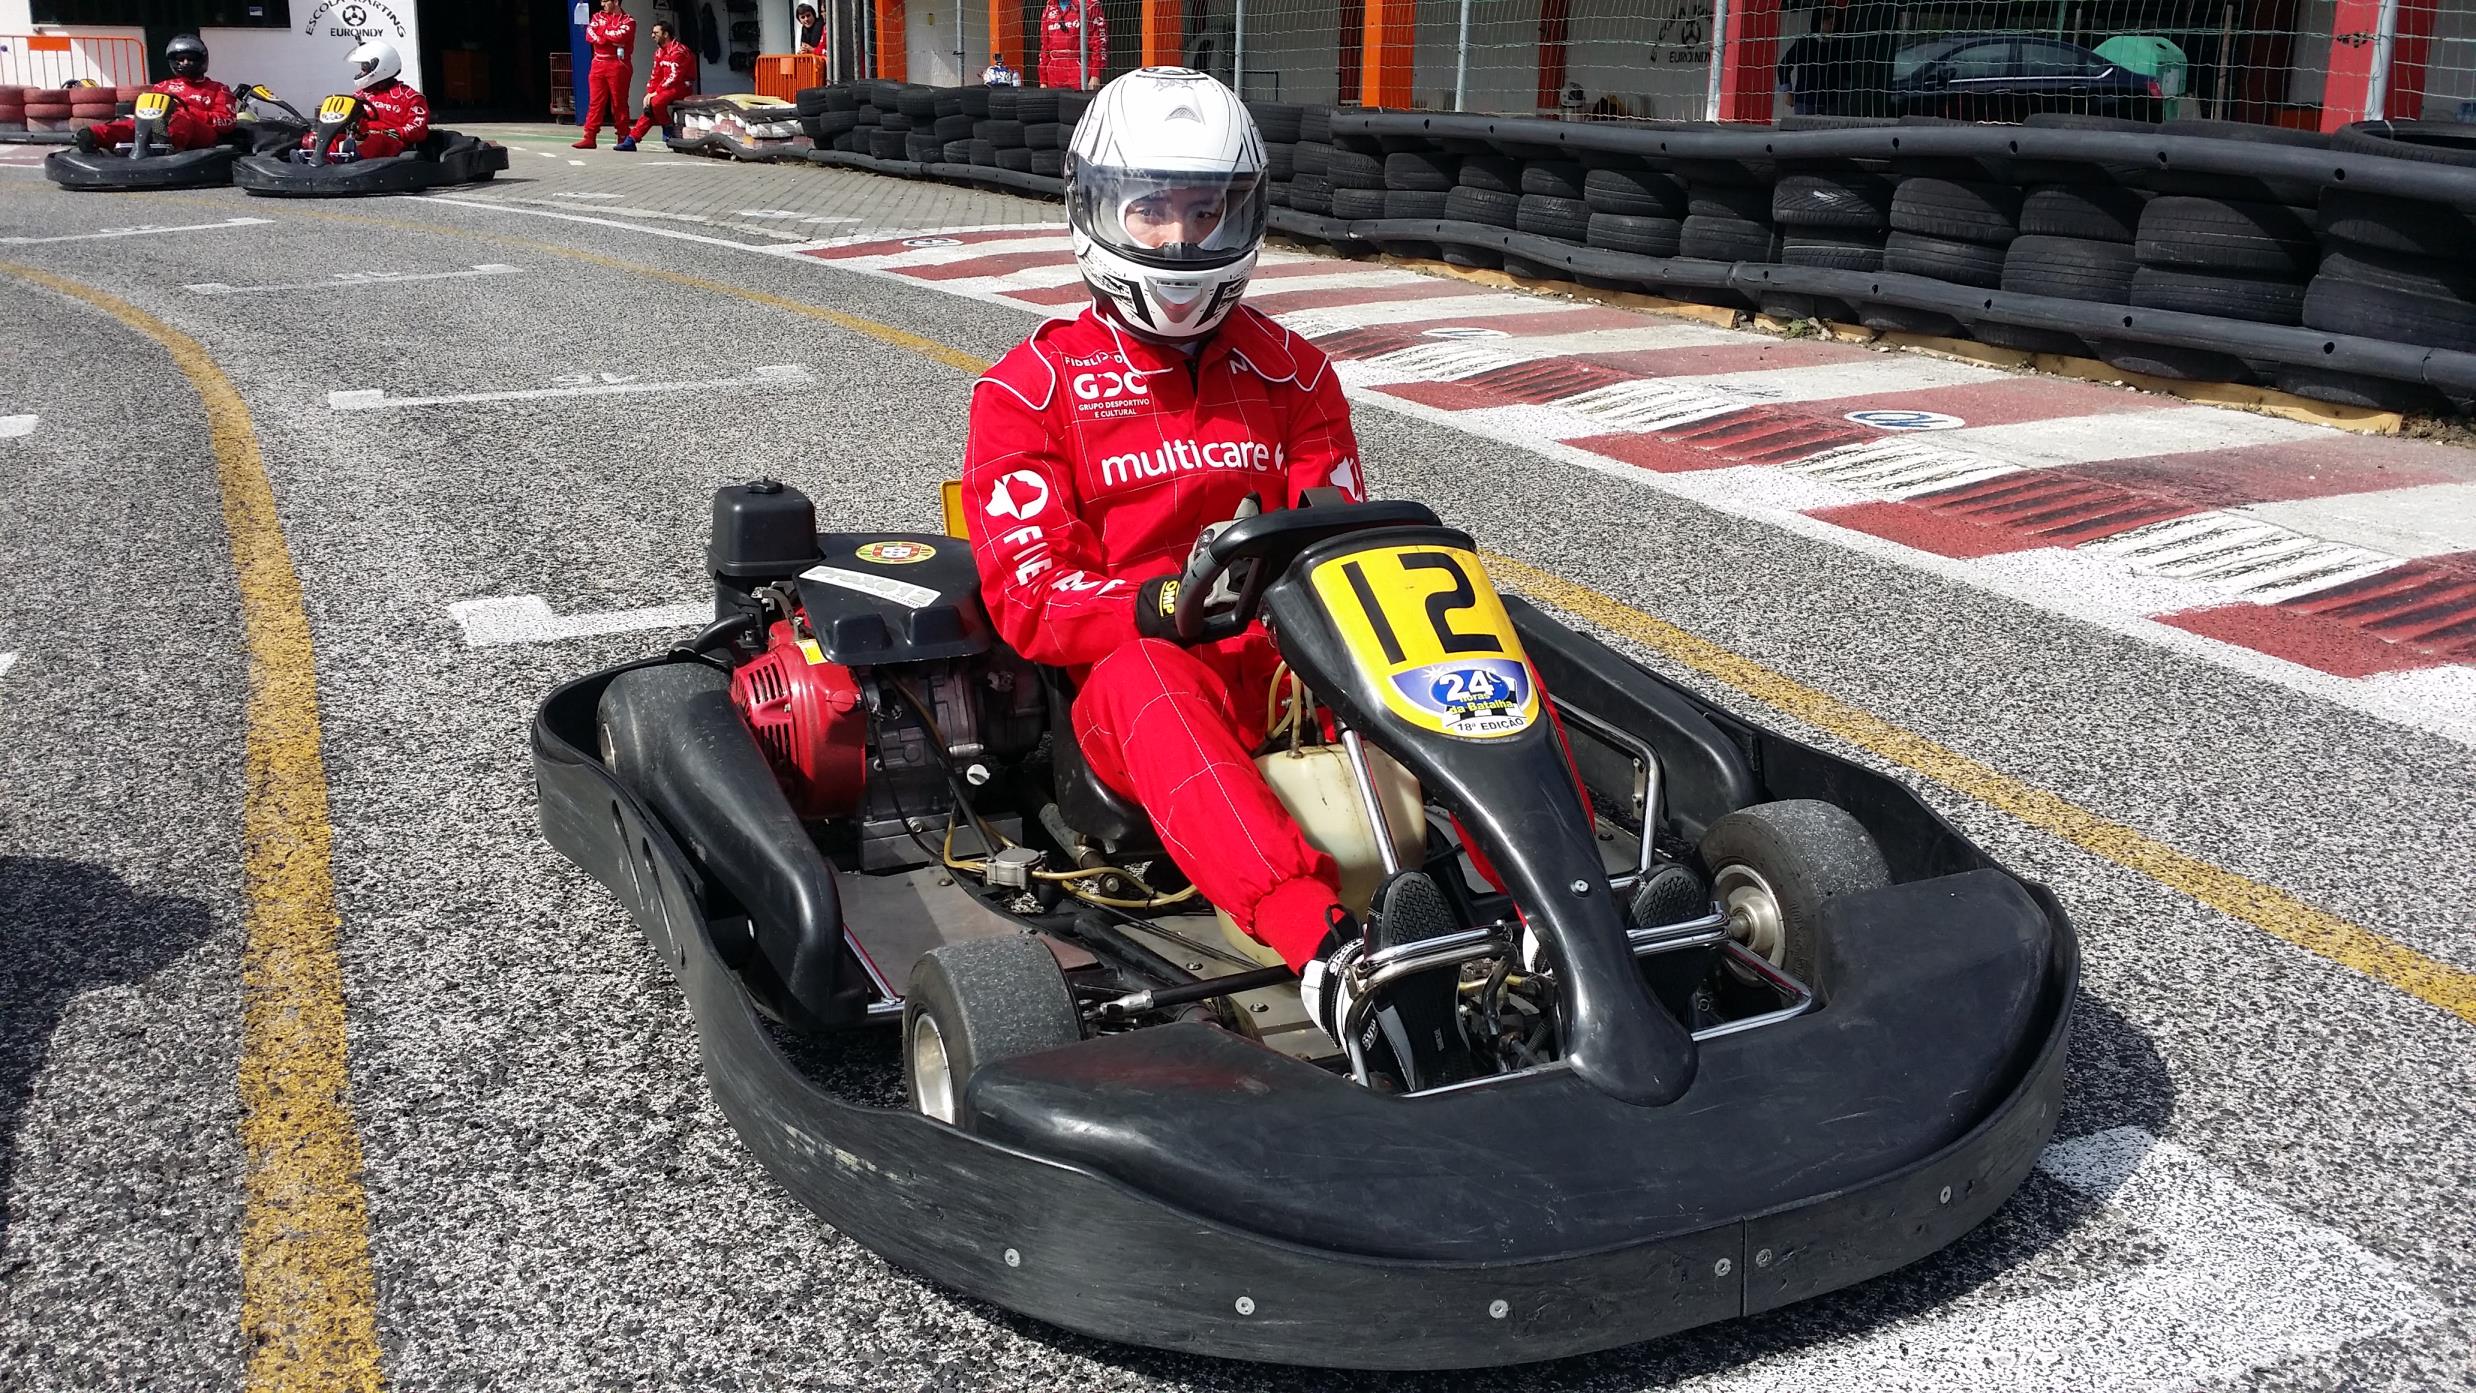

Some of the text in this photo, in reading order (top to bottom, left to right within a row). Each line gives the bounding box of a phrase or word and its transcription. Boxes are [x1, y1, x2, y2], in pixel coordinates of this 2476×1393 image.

[330, 28, 383, 37] EUROINDY
[151, 95, 165, 109] 11
[327, 97, 345, 113] 10
[1073, 371, 1148, 399] GDC
[1078, 398, 1149, 411] GRUPO DESPORTIVO
[1101, 408, 1137, 418] CULTURAL
[1101, 438, 1269, 487] multicare
[1162, 580, 1178, 614] OMP
[1342, 551, 1504, 665] 12
[1440, 670, 1494, 702] 24
[1449, 699, 1514, 715] da Batalha
[1481, 717, 1525, 731] EDIÇÃO
